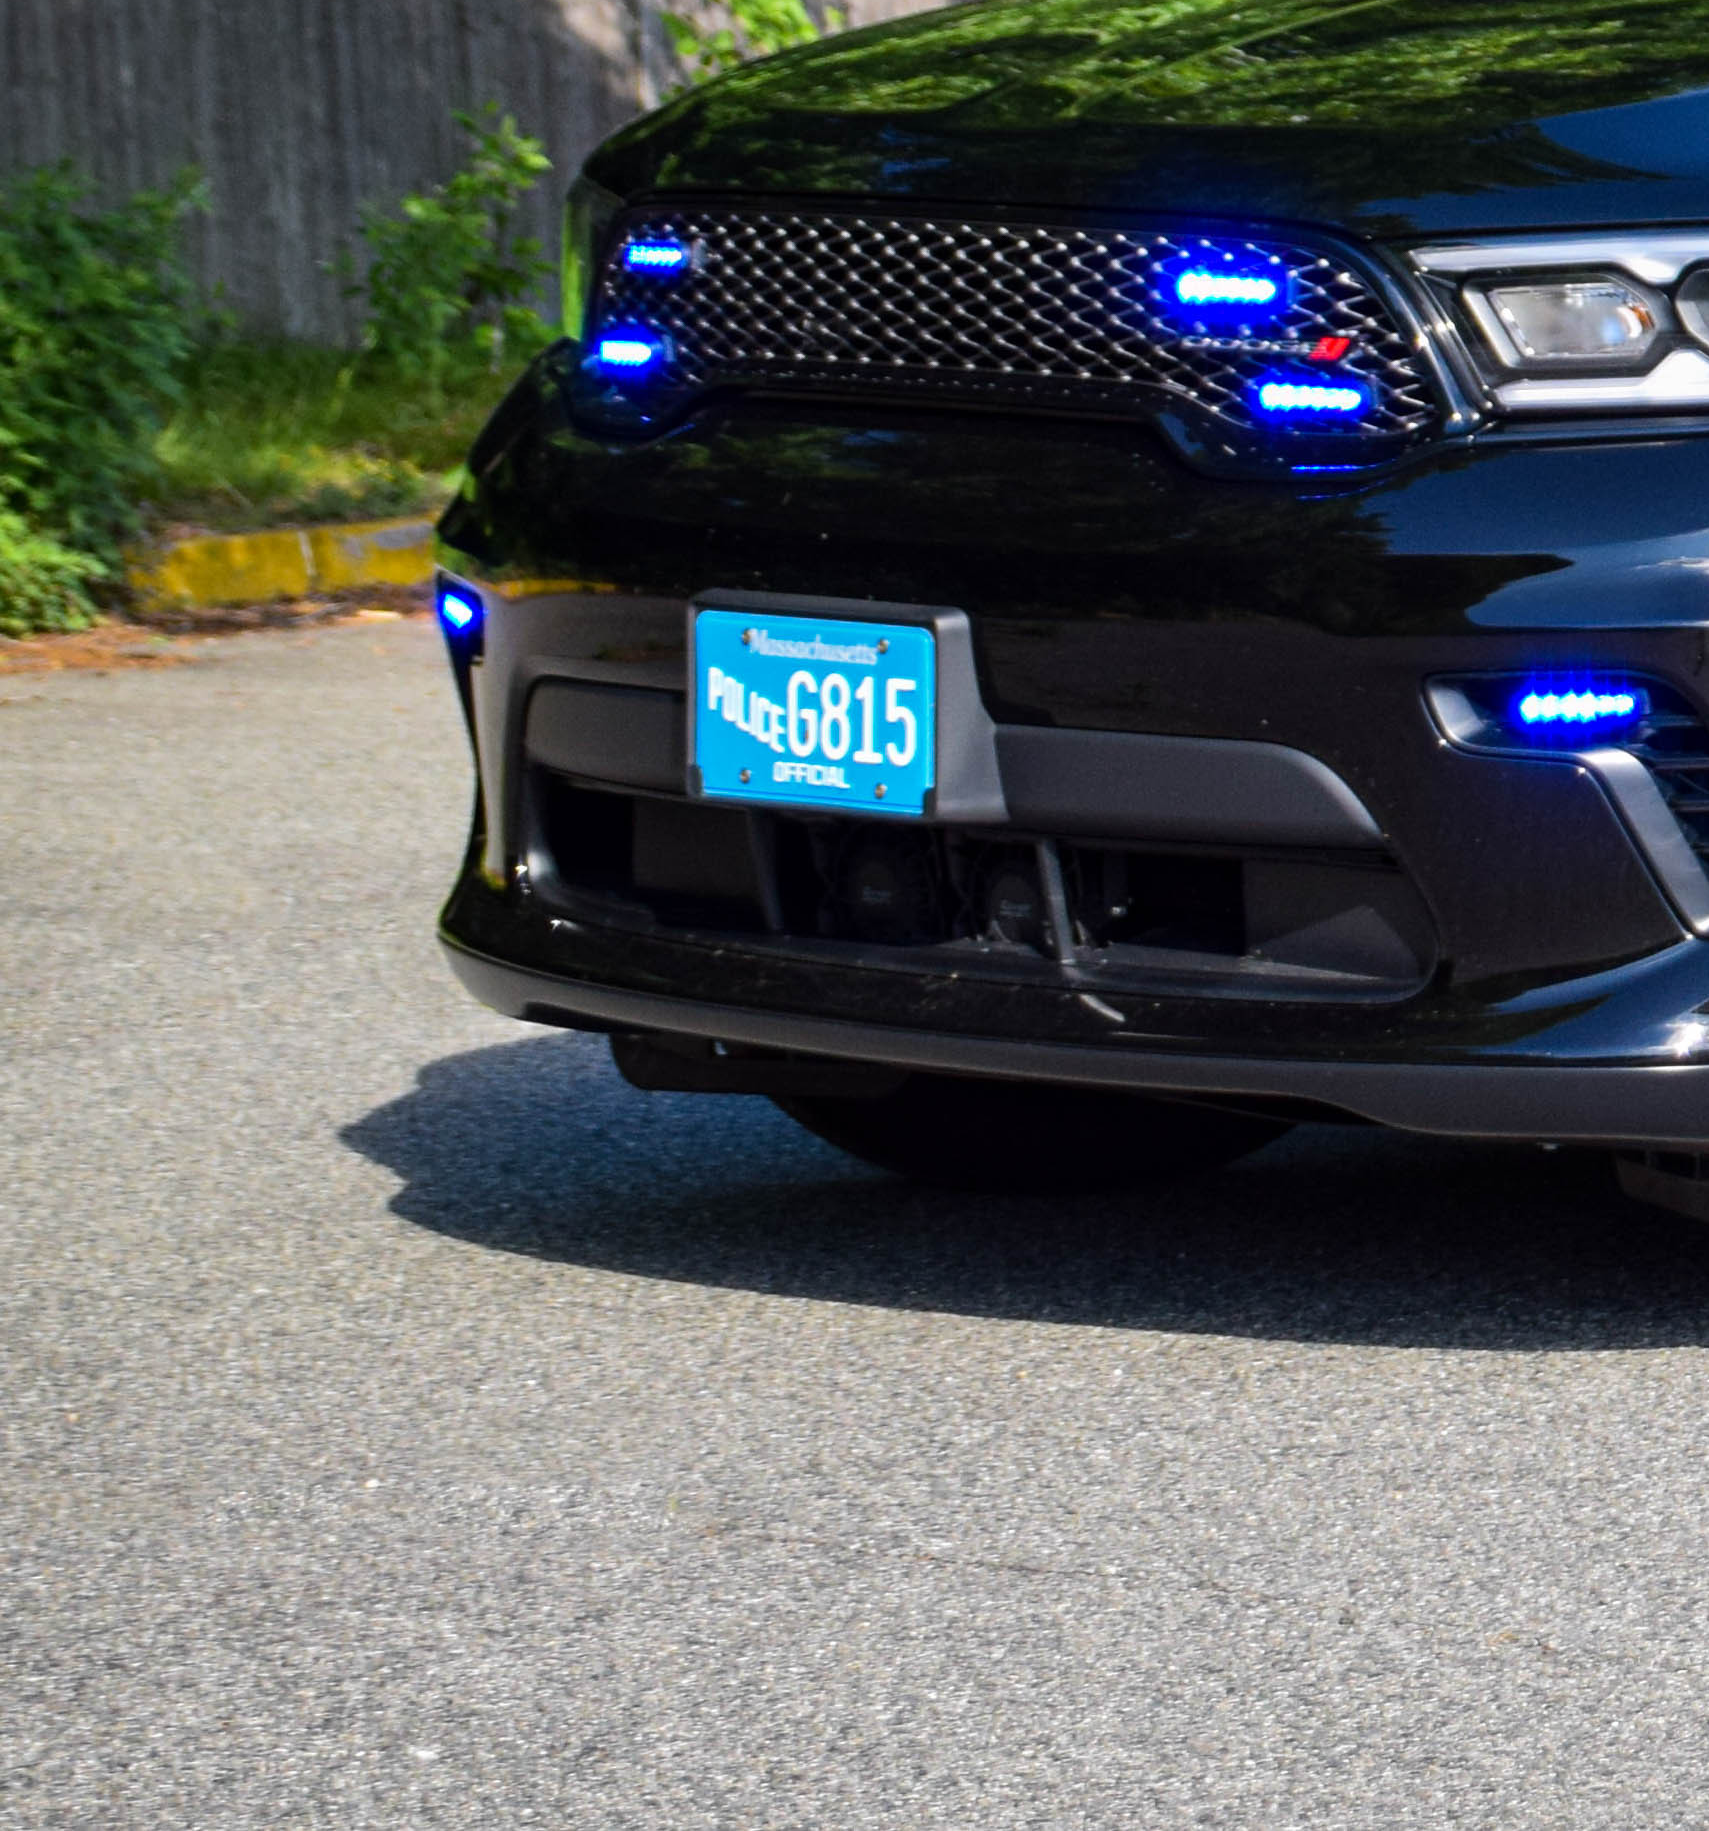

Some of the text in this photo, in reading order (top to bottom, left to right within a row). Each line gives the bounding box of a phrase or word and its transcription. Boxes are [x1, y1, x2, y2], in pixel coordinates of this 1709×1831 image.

[749, 629, 878, 665] Massachusetts
[708, 666, 917, 767] POLICE G815
[772, 761, 851, 789] OFFICIAL
